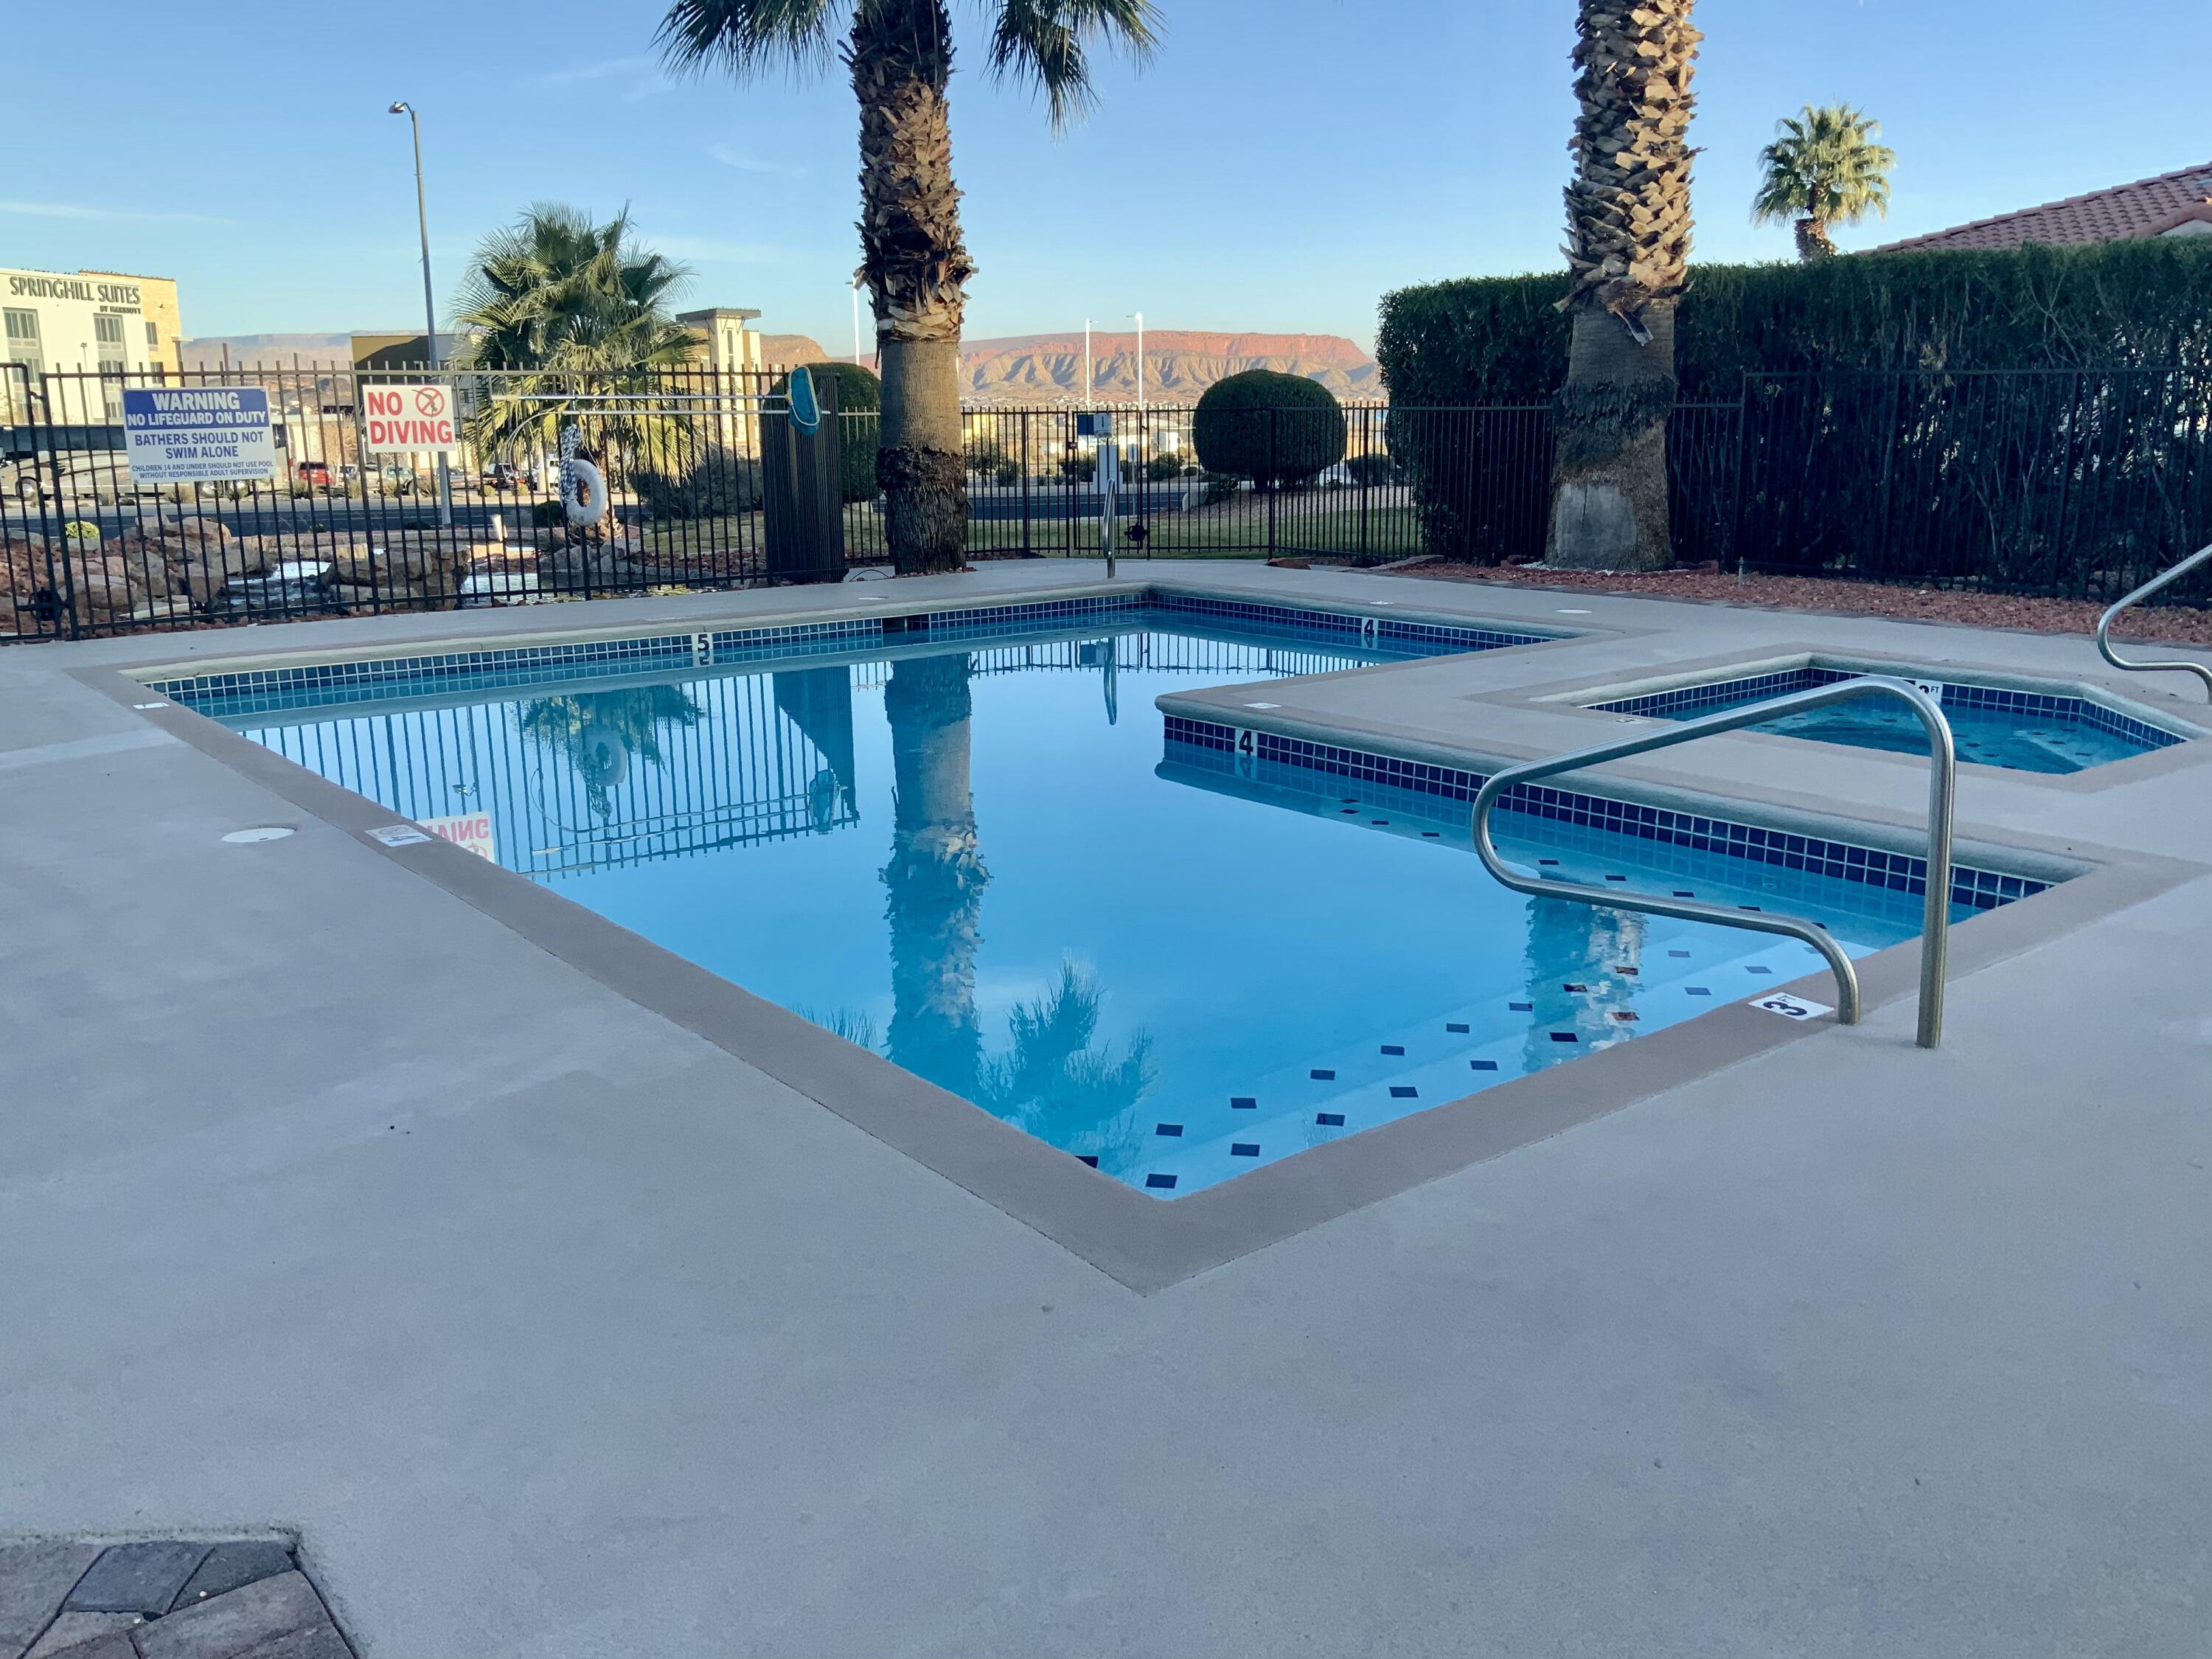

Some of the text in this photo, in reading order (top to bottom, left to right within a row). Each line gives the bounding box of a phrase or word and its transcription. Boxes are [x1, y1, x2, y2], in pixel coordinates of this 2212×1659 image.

[10, 276, 141, 305] SPRINGHILL SUITES
[151, 392, 240, 411] WARNING
[368, 392, 403, 416] NO
[128, 411, 266, 426] NO LIFEGUARD ON DUTY
[135, 431, 264, 446] BATHERS SHOULD NOT
[369, 420, 453, 445] DIVING
[166, 445, 239, 459] SWIM ALONE
[1364, 619, 1375, 634] 4
[698, 634, 709, 651] 5
[1239, 731, 1253, 755] 4
[1763, 1001, 1807, 1016] 3
